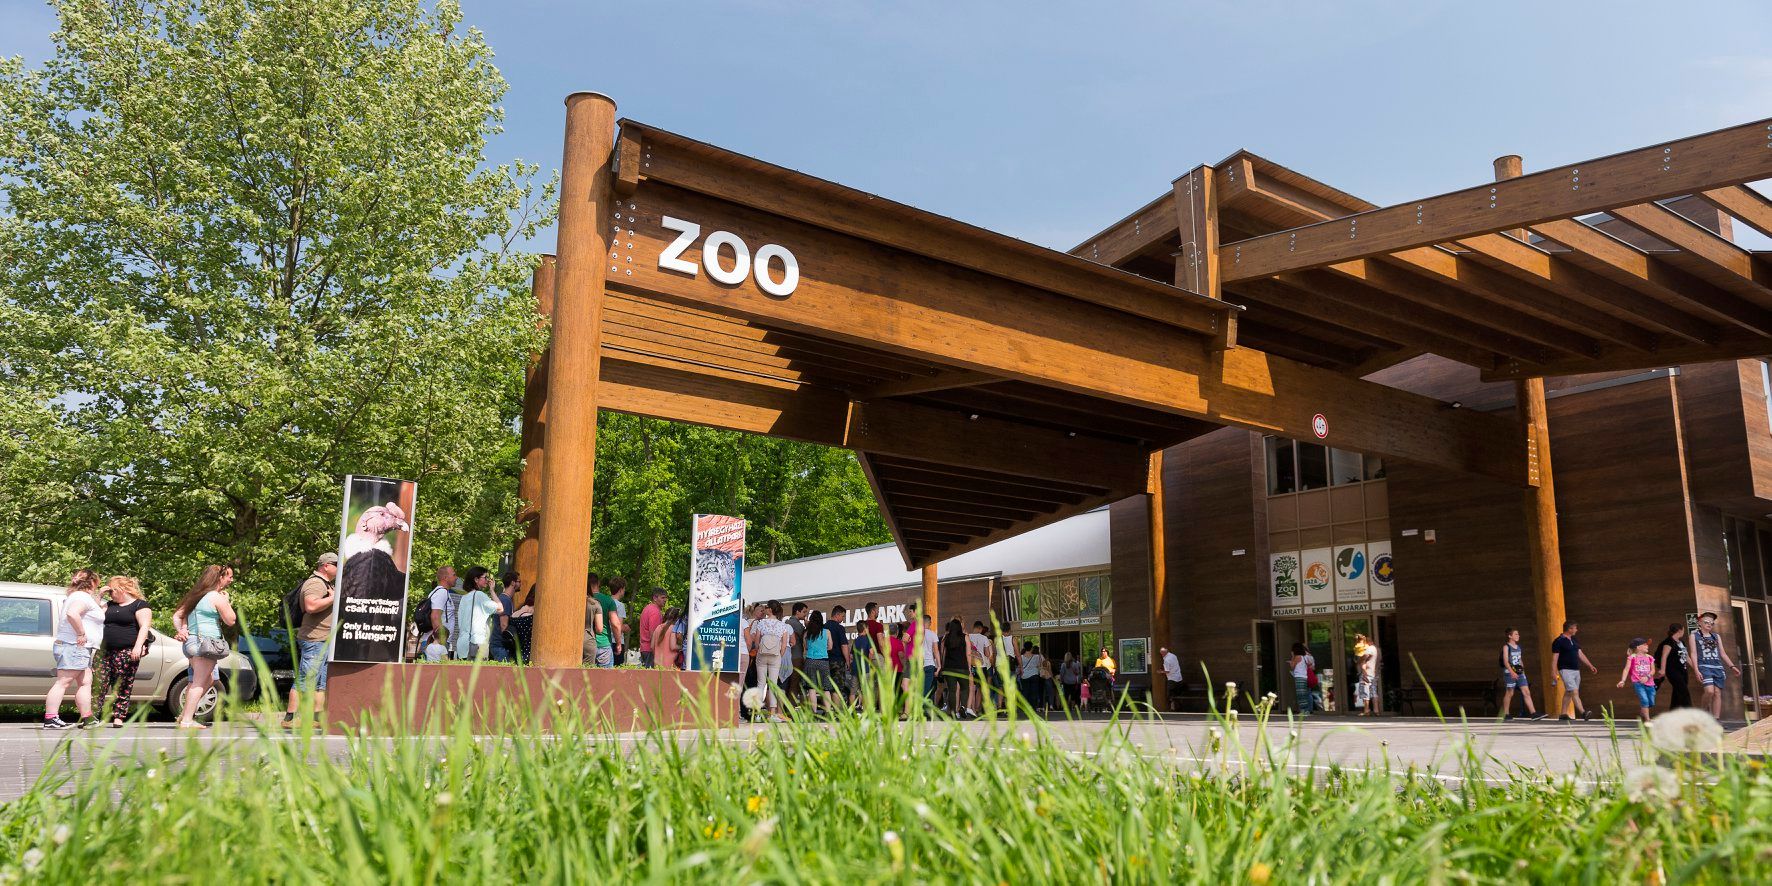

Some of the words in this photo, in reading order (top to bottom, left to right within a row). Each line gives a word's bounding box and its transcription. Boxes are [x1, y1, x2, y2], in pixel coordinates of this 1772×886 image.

[658, 215, 800, 296] ZOO
[1273, 608, 1302, 616] KIJÁRAT
[1311, 606, 1328, 614] EXIT
[1338, 603, 1368, 612] KIJÁRAT
[343, 622, 362, 631] Only
[362, 623, 371, 631] in
[342, 630, 353, 640] in
[354, 631, 398, 642] Hungary!
